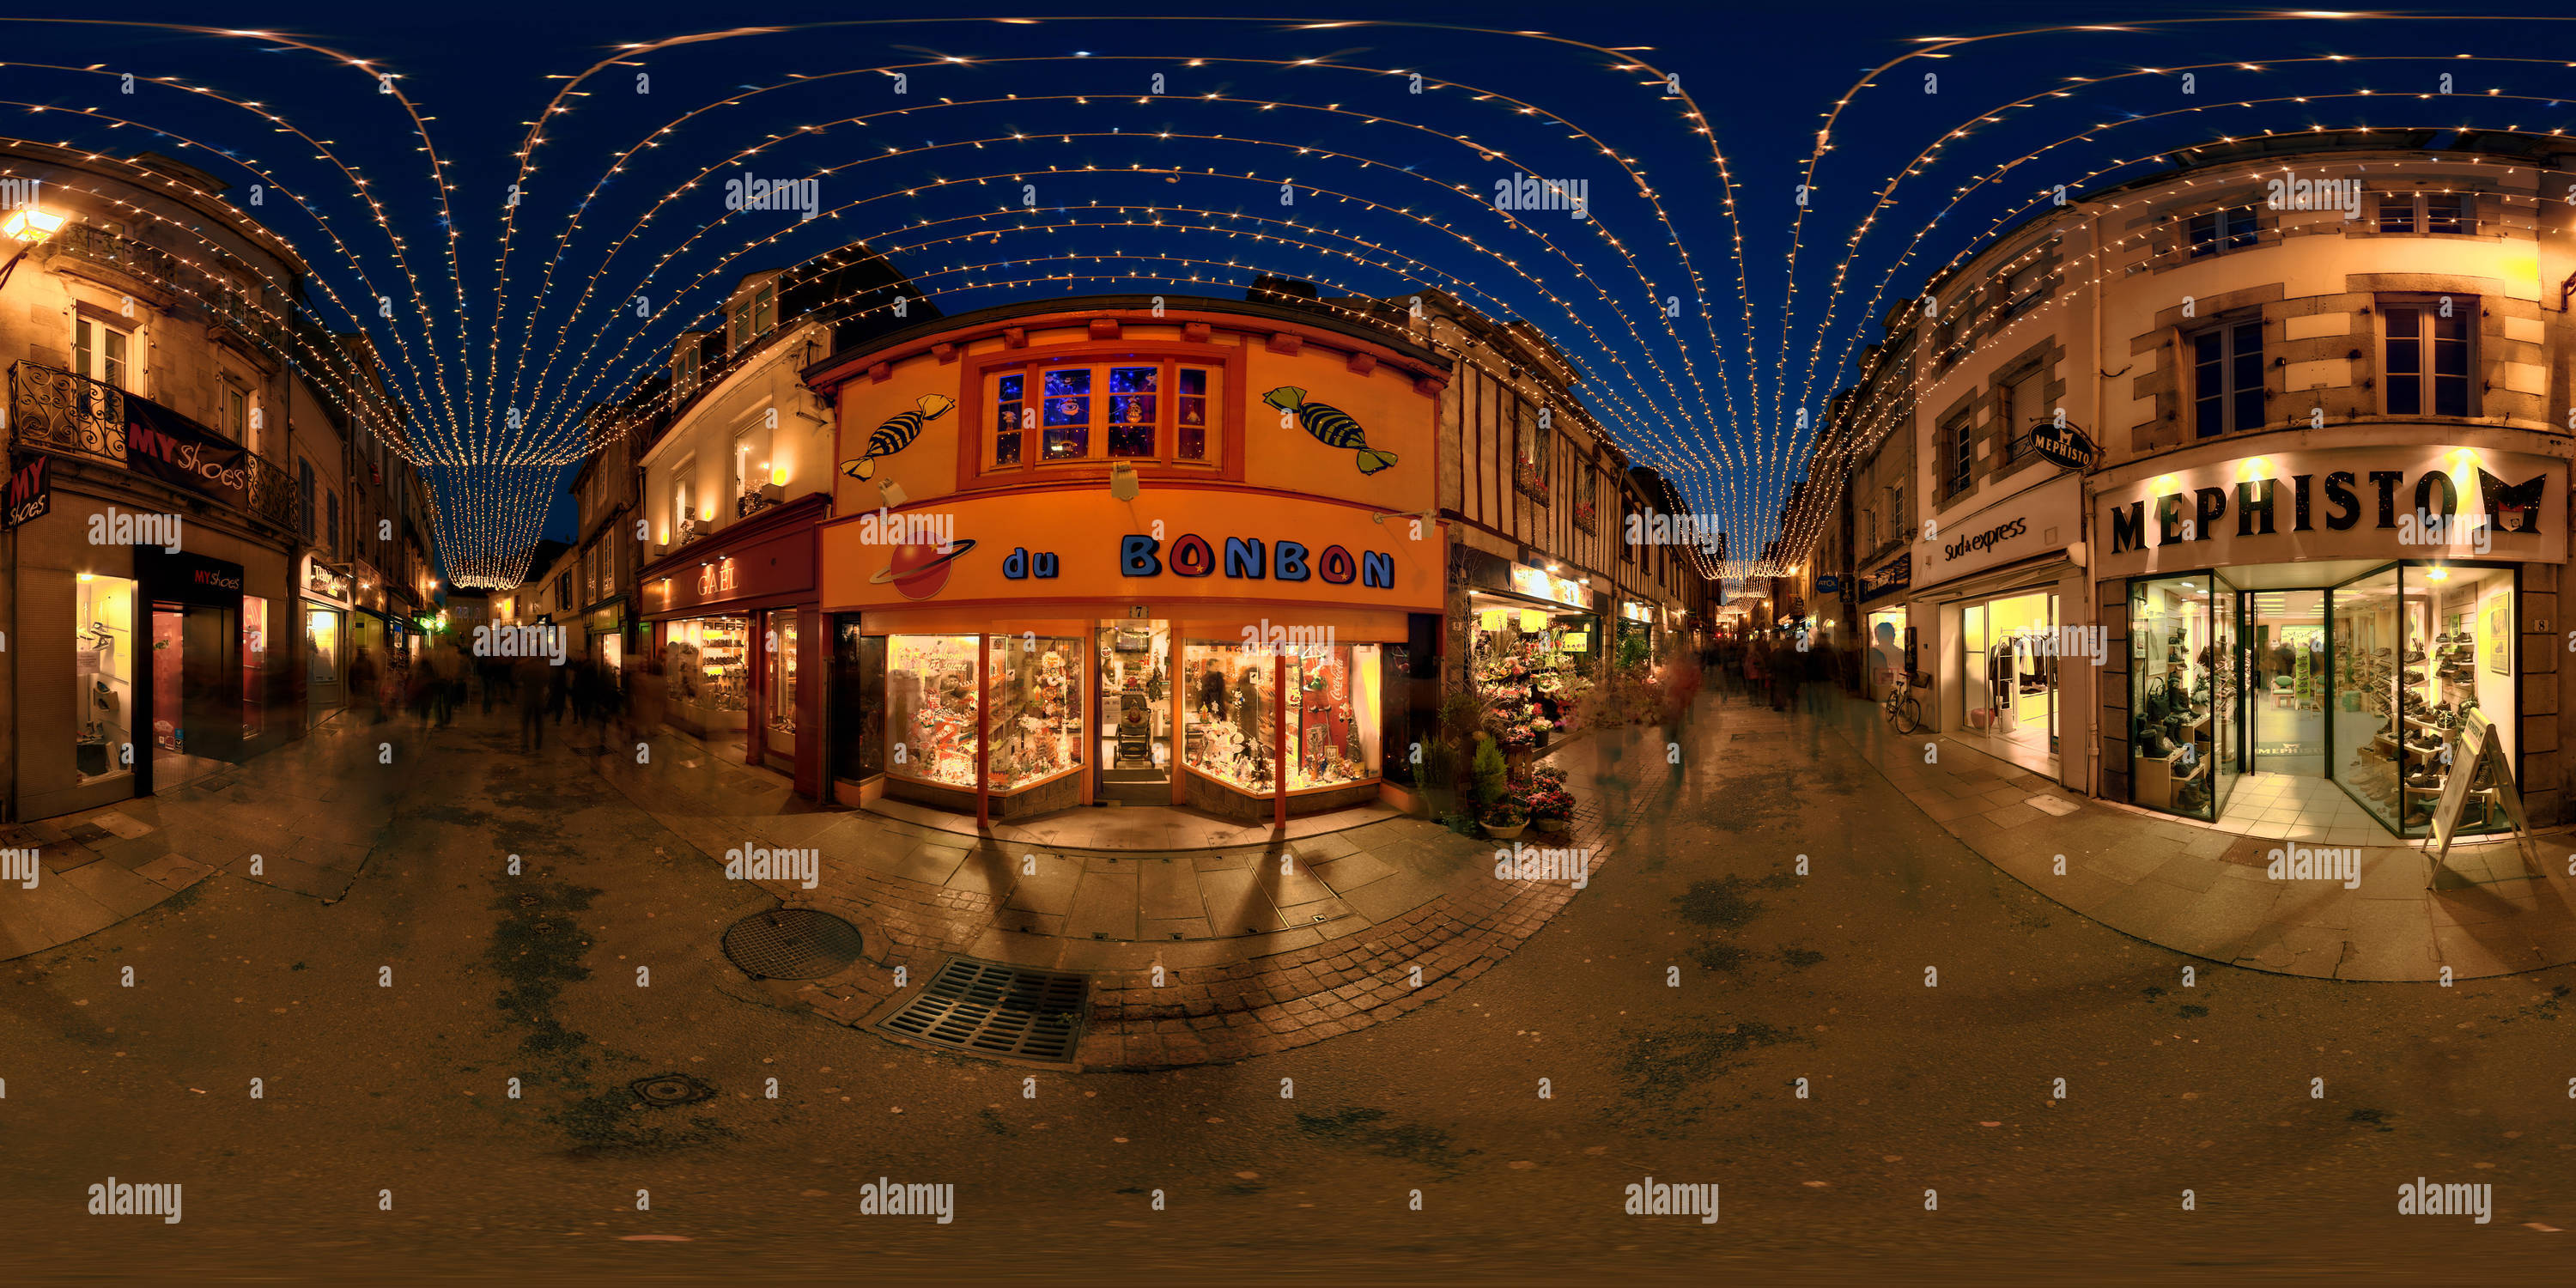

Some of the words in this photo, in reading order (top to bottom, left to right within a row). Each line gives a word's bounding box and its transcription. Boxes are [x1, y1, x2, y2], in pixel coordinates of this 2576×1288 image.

[129, 422, 178, 465] MY
[2034, 434, 2090, 465] MEPHISTO
[9, 455, 47, 507] MY
[2110, 470, 2458, 555] MEPHISTO
[1971, 517, 2026, 553] express
[194, 569, 211, 585] MY
[1002, 547, 1060, 580] du
[1120, 533, 1395, 590] BONBON
[696, 564, 739, 596] GAËL
[1135, 606, 1142, 617] 7
[2538, 620, 2545, 632] 8
